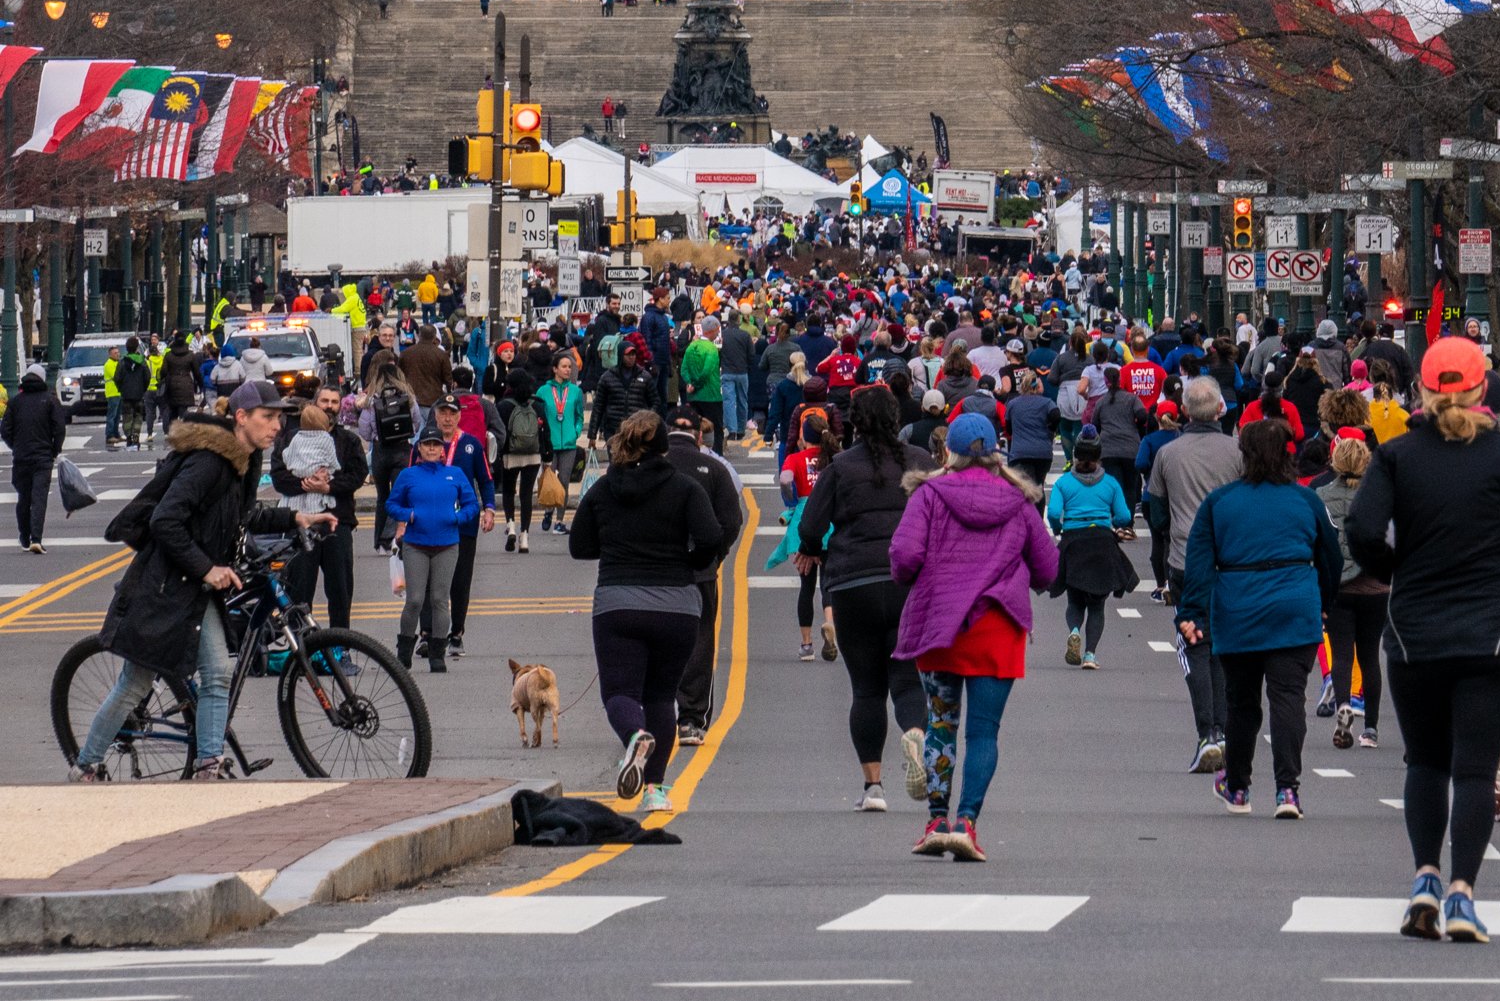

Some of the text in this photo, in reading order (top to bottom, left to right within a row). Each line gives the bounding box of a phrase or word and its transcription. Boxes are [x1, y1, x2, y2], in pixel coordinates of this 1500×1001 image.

[1153, 221, 1166, 232] G-1
[1188, 233, 1202, 245] H-1
[1365, 233, 1382, 249] J-1
[85, 241, 102, 253] H-2
[620, 291, 635, 300] NO
[1130, 368, 1155, 377] LOVE
[1131, 375, 1155, 384] RUN
[1132, 383, 1154, 391] PHILLY
